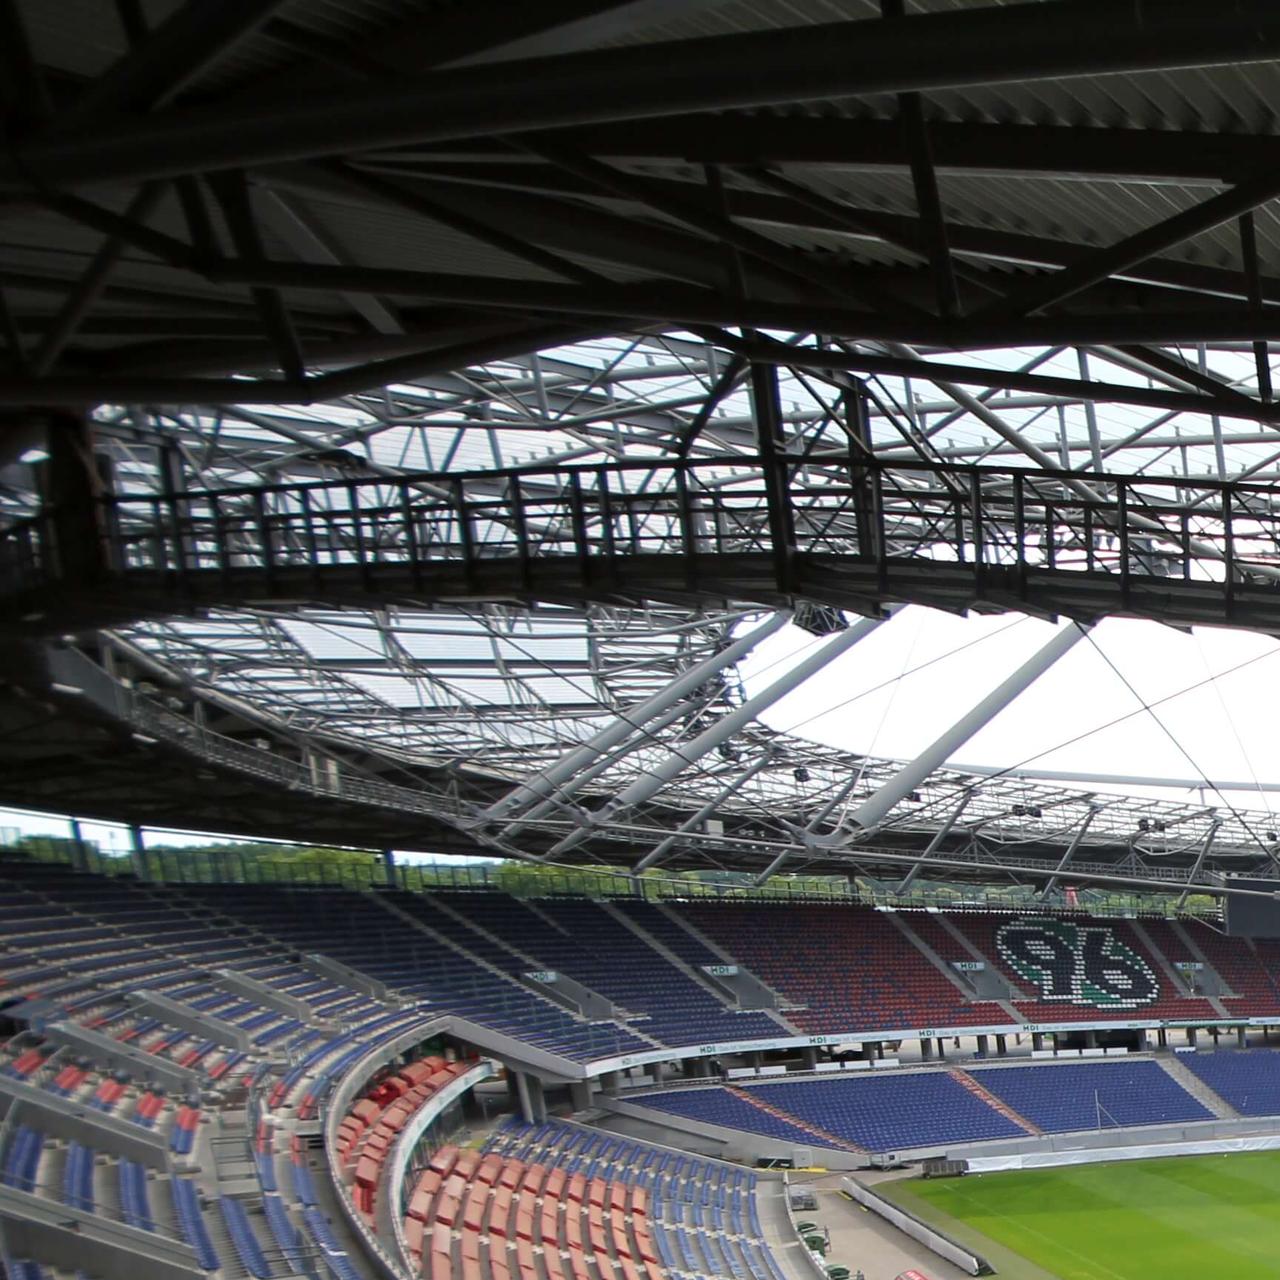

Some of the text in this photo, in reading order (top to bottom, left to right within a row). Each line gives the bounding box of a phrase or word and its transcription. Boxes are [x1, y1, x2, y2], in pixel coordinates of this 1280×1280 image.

[997, 917, 1159, 1008] 96
[711, 966, 729, 974] HDI
[532, 972, 549, 980] HDI
[809, 1036, 826, 1044] HDI
[700, 1046, 716, 1054] HDI
